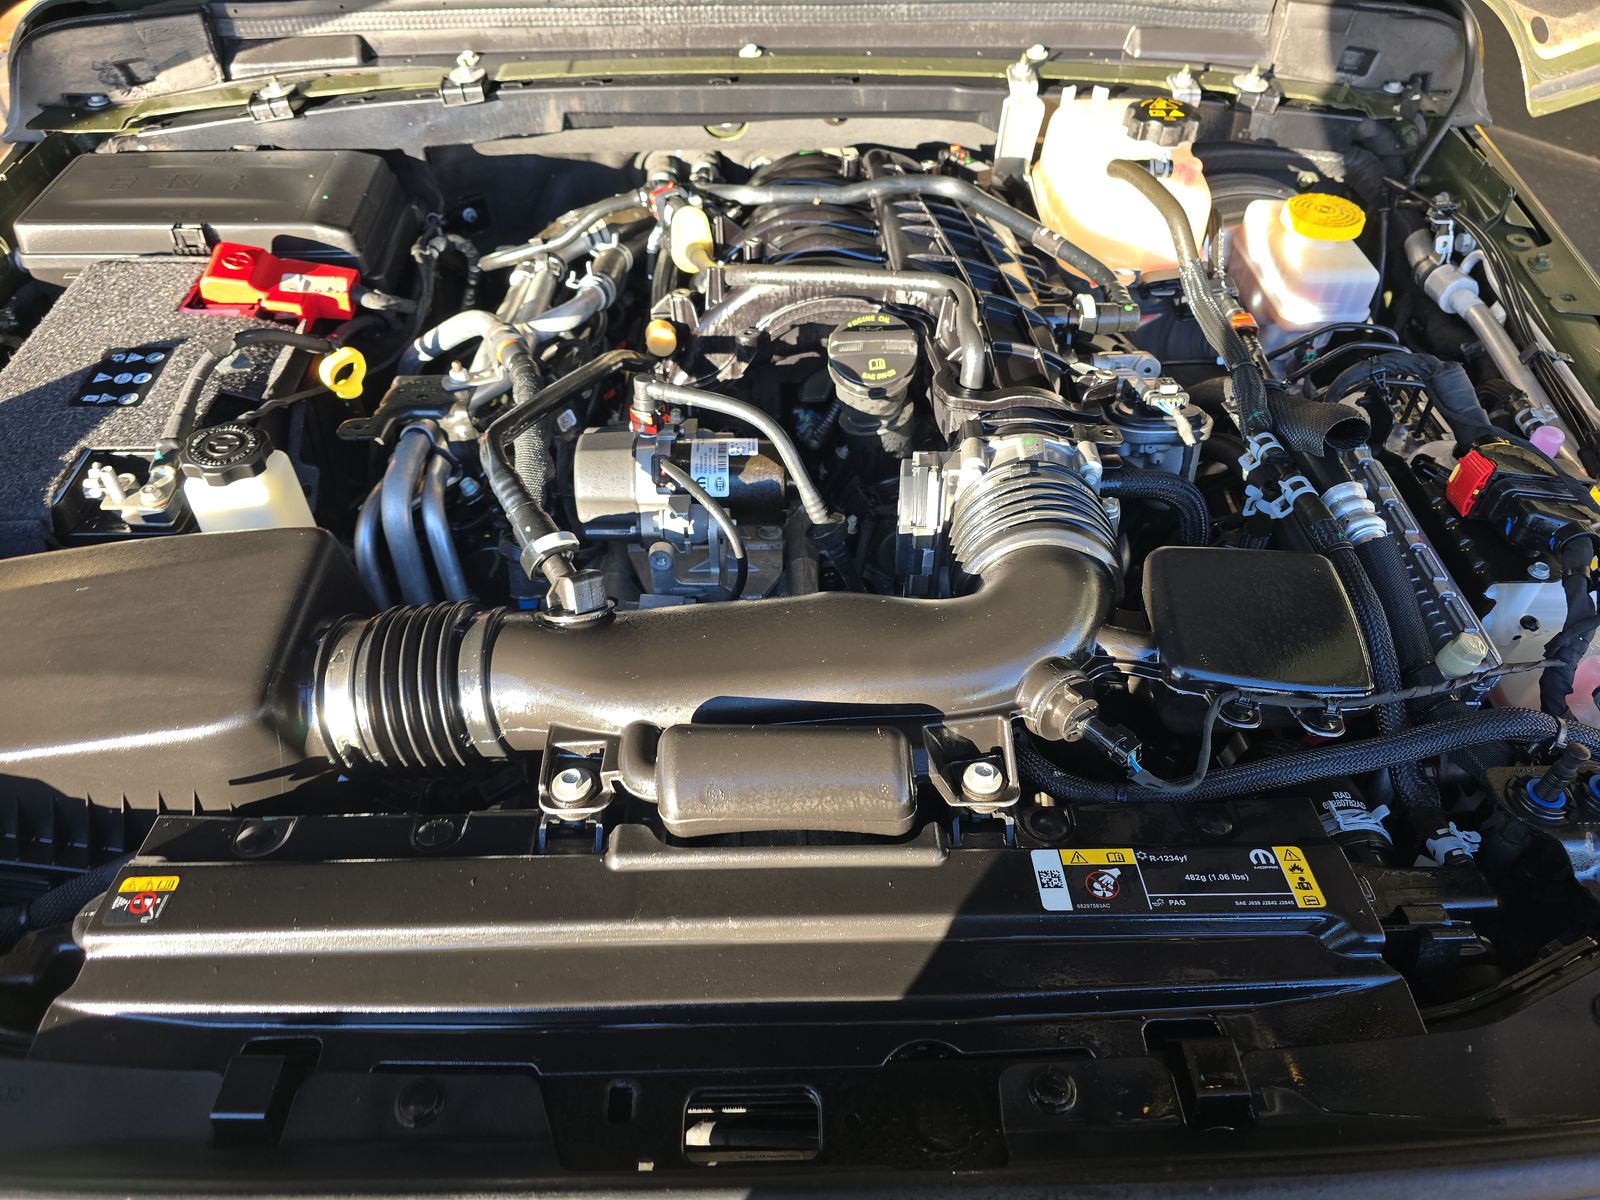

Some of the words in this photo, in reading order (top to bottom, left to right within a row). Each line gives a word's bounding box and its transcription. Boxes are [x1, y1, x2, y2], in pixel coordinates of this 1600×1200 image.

[847, 315, 876, 328] ENGINE
[878, 315, 891, 324] OIL
[1332, 791, 1352, 799] RAD
[1149, 854, 1188, 864] R-1234yf
[1184, 873, 1207, 882] 482g
[1208, 873, 1231, 882] (1.06
[1231, 873, 1250, 882] lbs)
